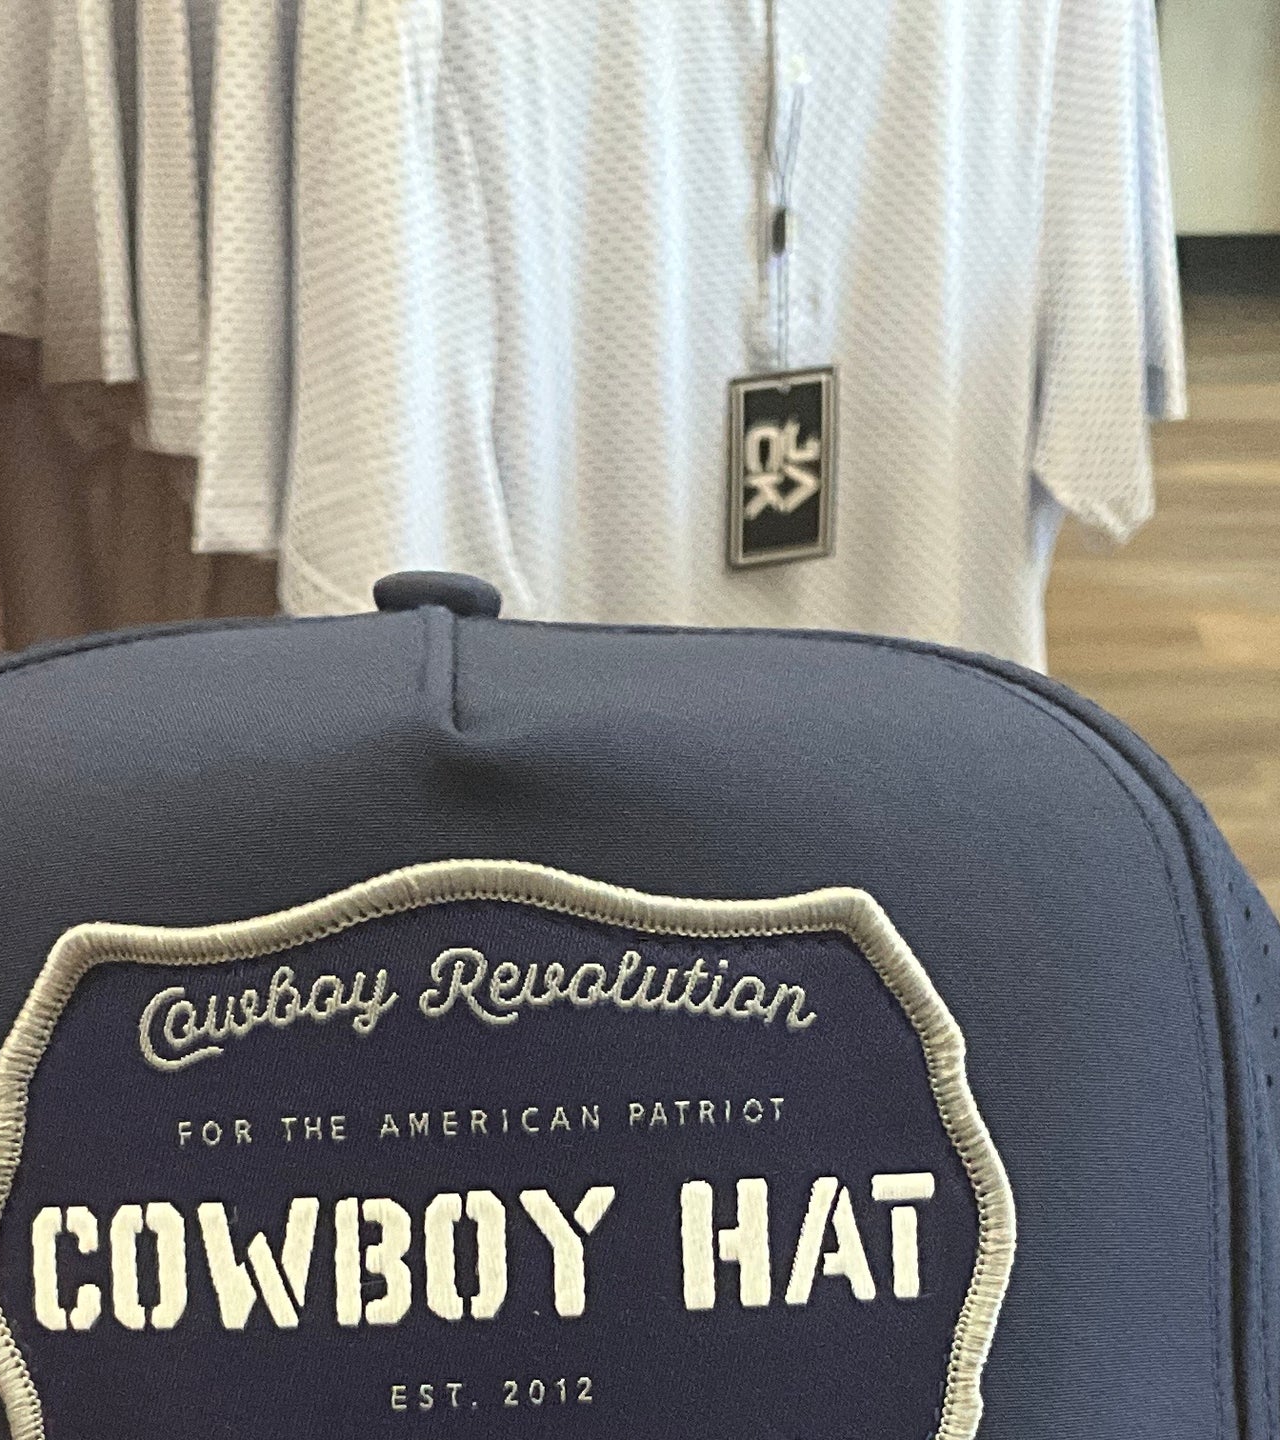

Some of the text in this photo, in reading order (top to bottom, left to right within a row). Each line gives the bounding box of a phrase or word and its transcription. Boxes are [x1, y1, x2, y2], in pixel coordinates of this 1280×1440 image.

[138, 946, 817, 1069] Cowboy Revolution
[178, 1097, 786, 1146] FOR THE AMERICAN PATRIOT
[31, 1172, 935, 1330] COWBOY HAT
[392, 1376, 593, 1410] EST. 2012
